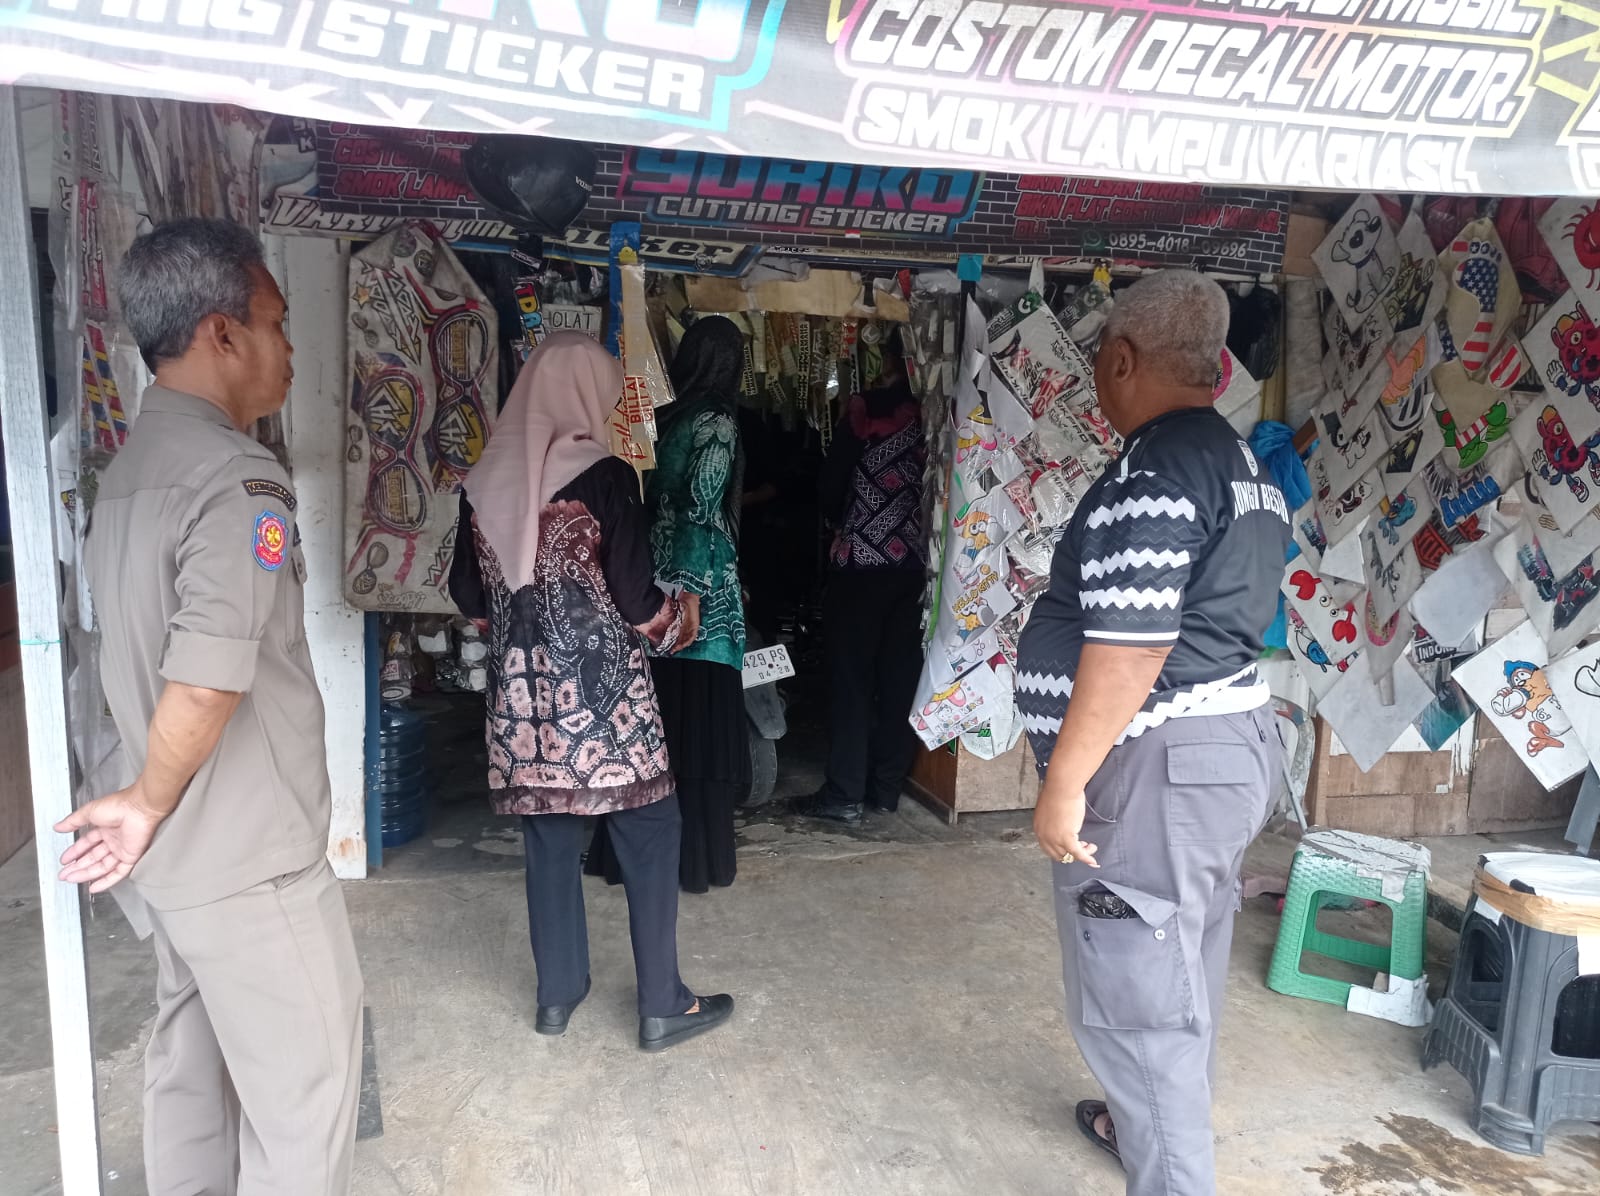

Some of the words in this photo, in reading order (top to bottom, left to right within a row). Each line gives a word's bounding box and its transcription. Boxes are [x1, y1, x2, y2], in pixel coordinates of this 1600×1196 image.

[317, 1, 705, 113] STICKER
[850, 0, 1138, 86] COSTOM
[1118, 19, 1317, 104] DECAL
[858, 87, 1042, 161] SMOK
[1046, 102, 1254, 182] LAMPU
[336, 170, 403, 198] SMOK
[403, 172, 476, 200] LAMP
[656, 196, 802, 225] CUTTING
[809, 206, 948, 234] STICKER
[1014, 192, 1064, 218] BIKIN
[1063, 196, 1109, 222] PLAT
[1183, 204, 1222, 228] DAN
[952, 588, 978, 613] HELLO
[977, 571, 999, 593] KITTY
[770, 648, 786, 662] PS
